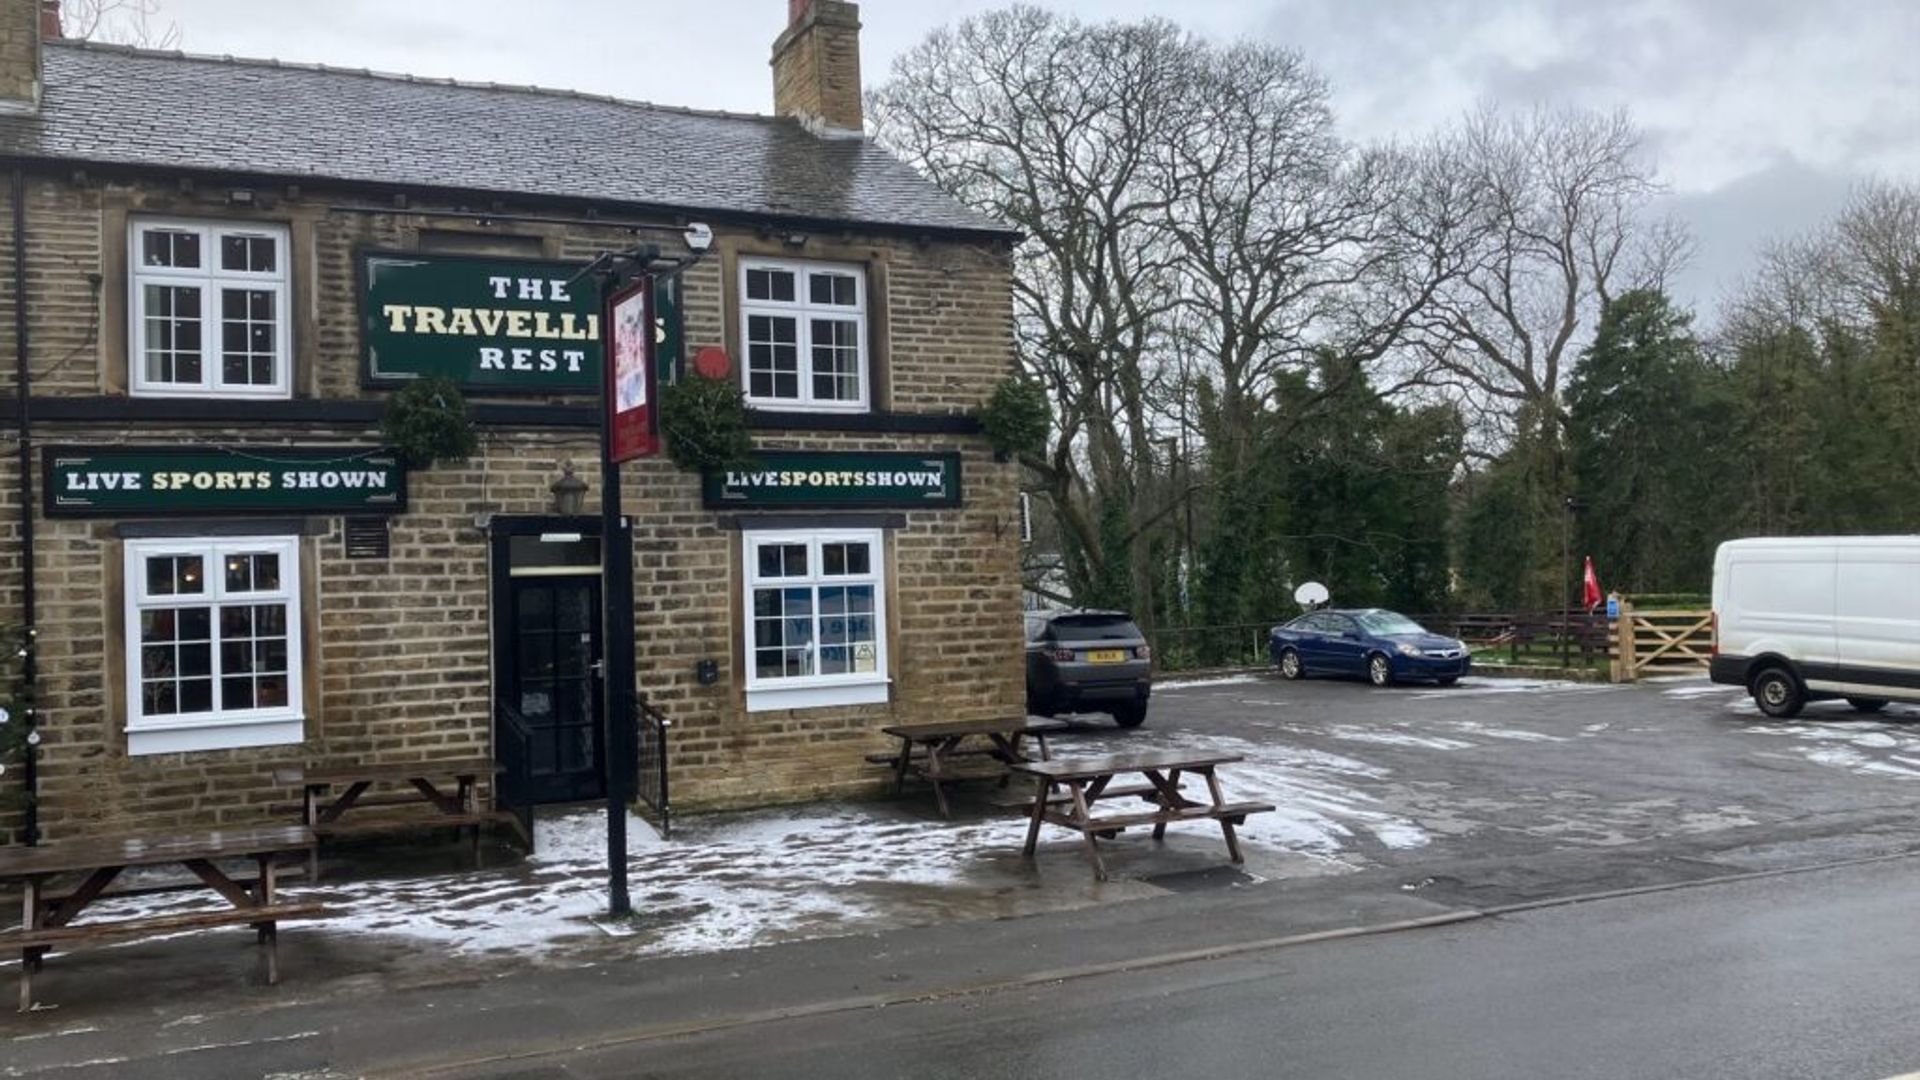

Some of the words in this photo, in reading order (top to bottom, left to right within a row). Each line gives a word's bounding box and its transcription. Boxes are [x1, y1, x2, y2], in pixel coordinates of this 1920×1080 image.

[489, 276, 571, 302] THE
[383, 304, 666, 344] TRAVELLS
[479, 347, 585, 372] REST
[67, 472, 141, 490] LIVE
[153, 471, 272, 490] SPORTS
[282, 471, 386, 488] SHOWN
